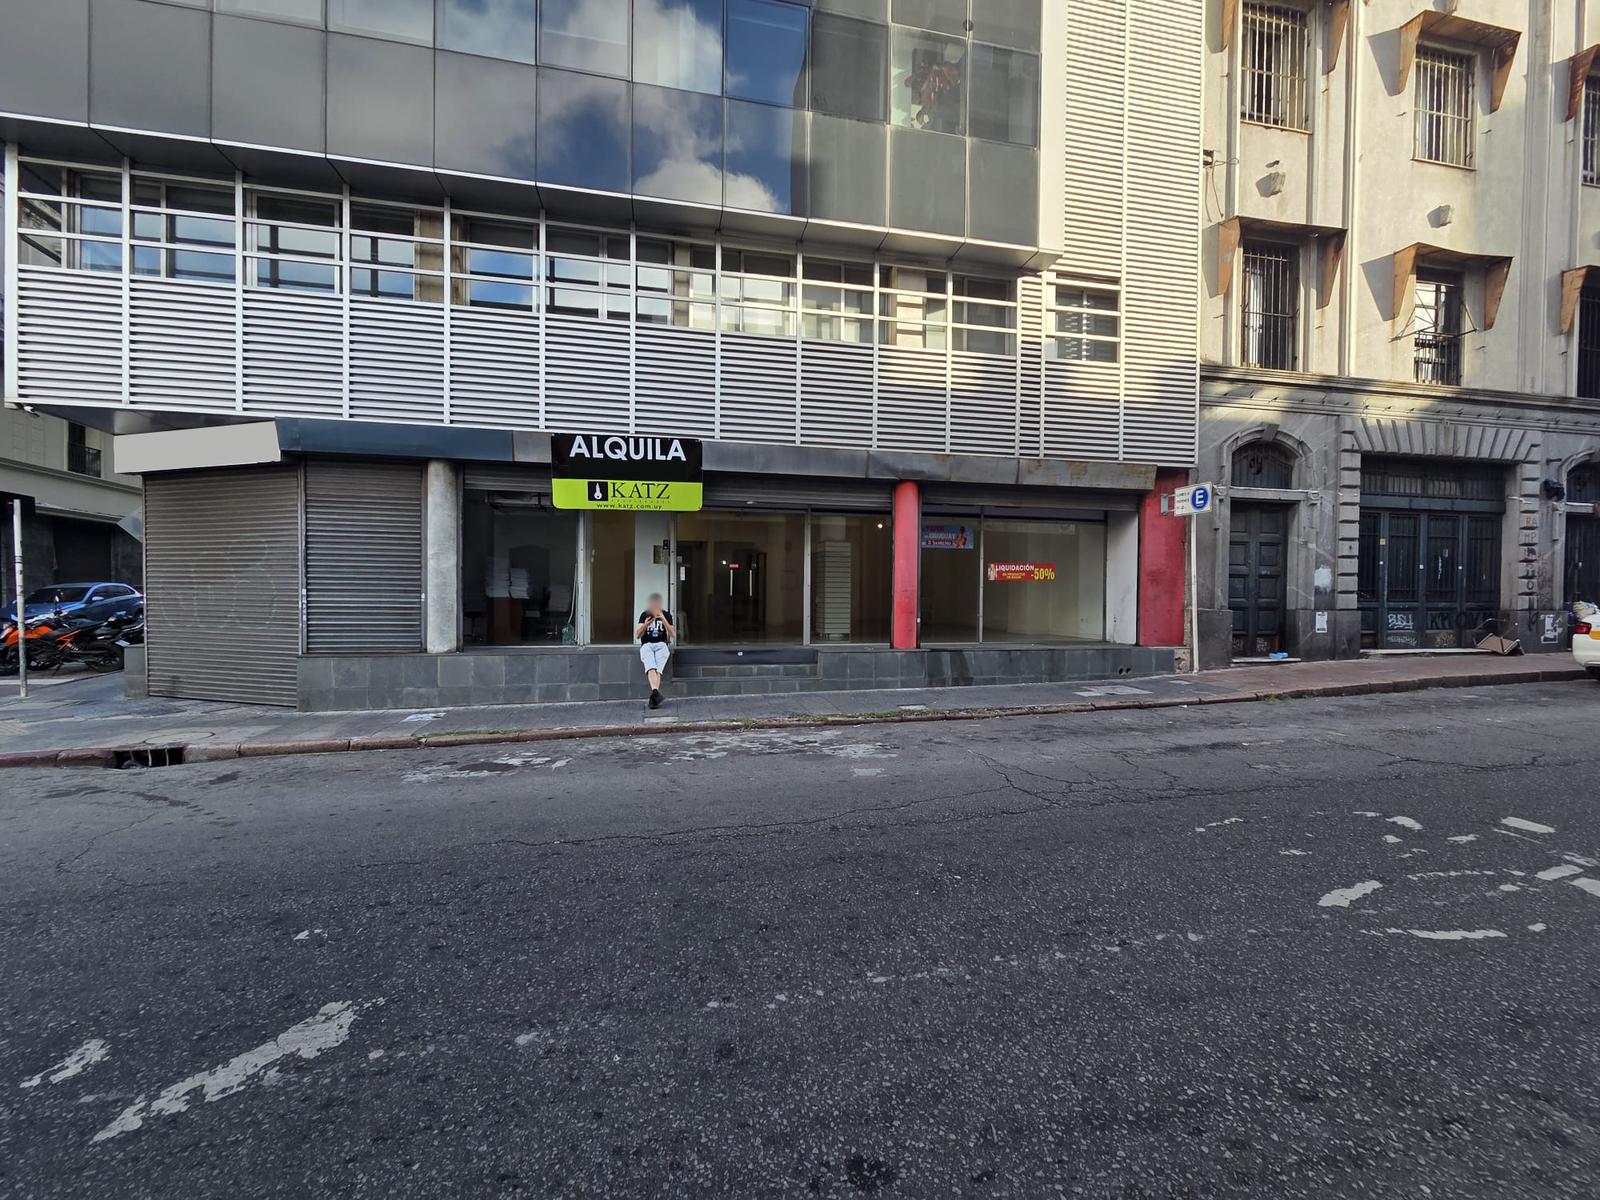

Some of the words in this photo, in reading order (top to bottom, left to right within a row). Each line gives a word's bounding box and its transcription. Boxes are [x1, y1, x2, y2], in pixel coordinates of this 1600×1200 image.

[569, 435, 687, 461] ALQUILA
[611, 482, 670, 498] KATZ
[1196, 490, 1204, 504] E
[995, 563, 1034, 571] LIQUIDACIÓN
[1031, 568, 1055, 580] -50%
